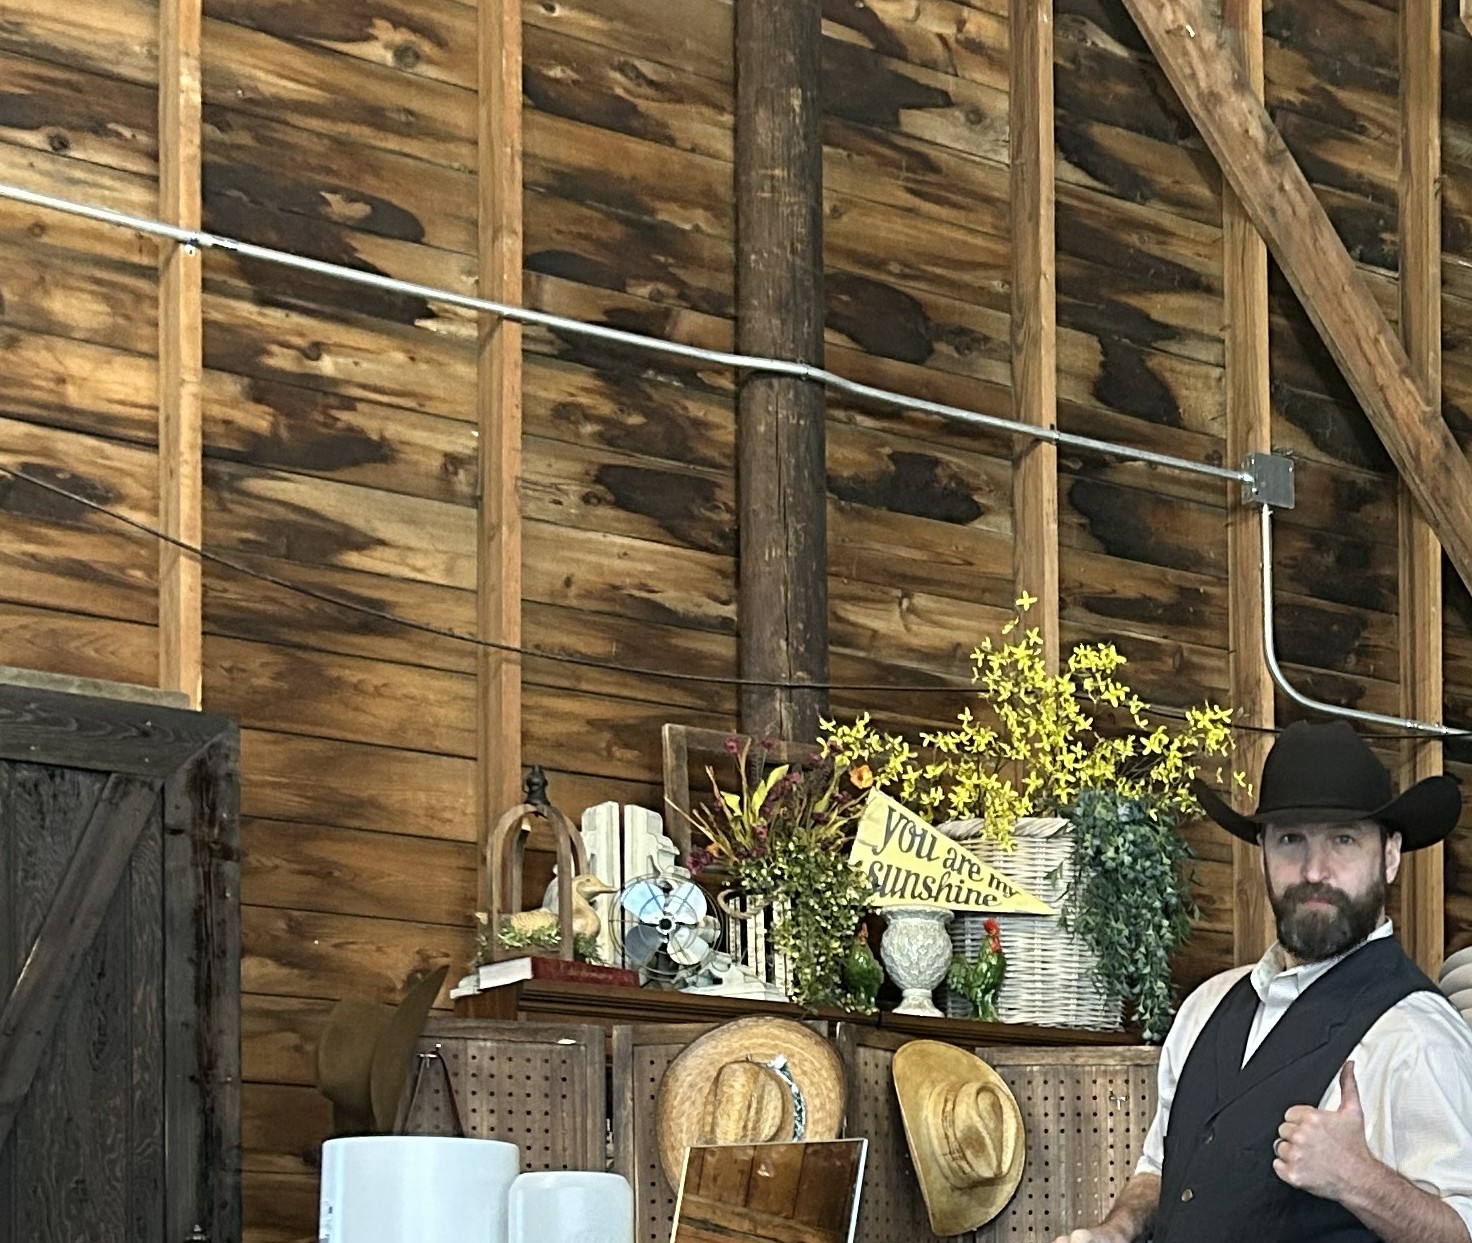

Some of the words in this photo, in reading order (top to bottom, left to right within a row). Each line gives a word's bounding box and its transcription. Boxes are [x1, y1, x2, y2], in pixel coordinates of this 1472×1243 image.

[868, 861, 1002, 907] sunshine
[943, 847, 984, 882] are
[988, 873, 1022, 898] my
